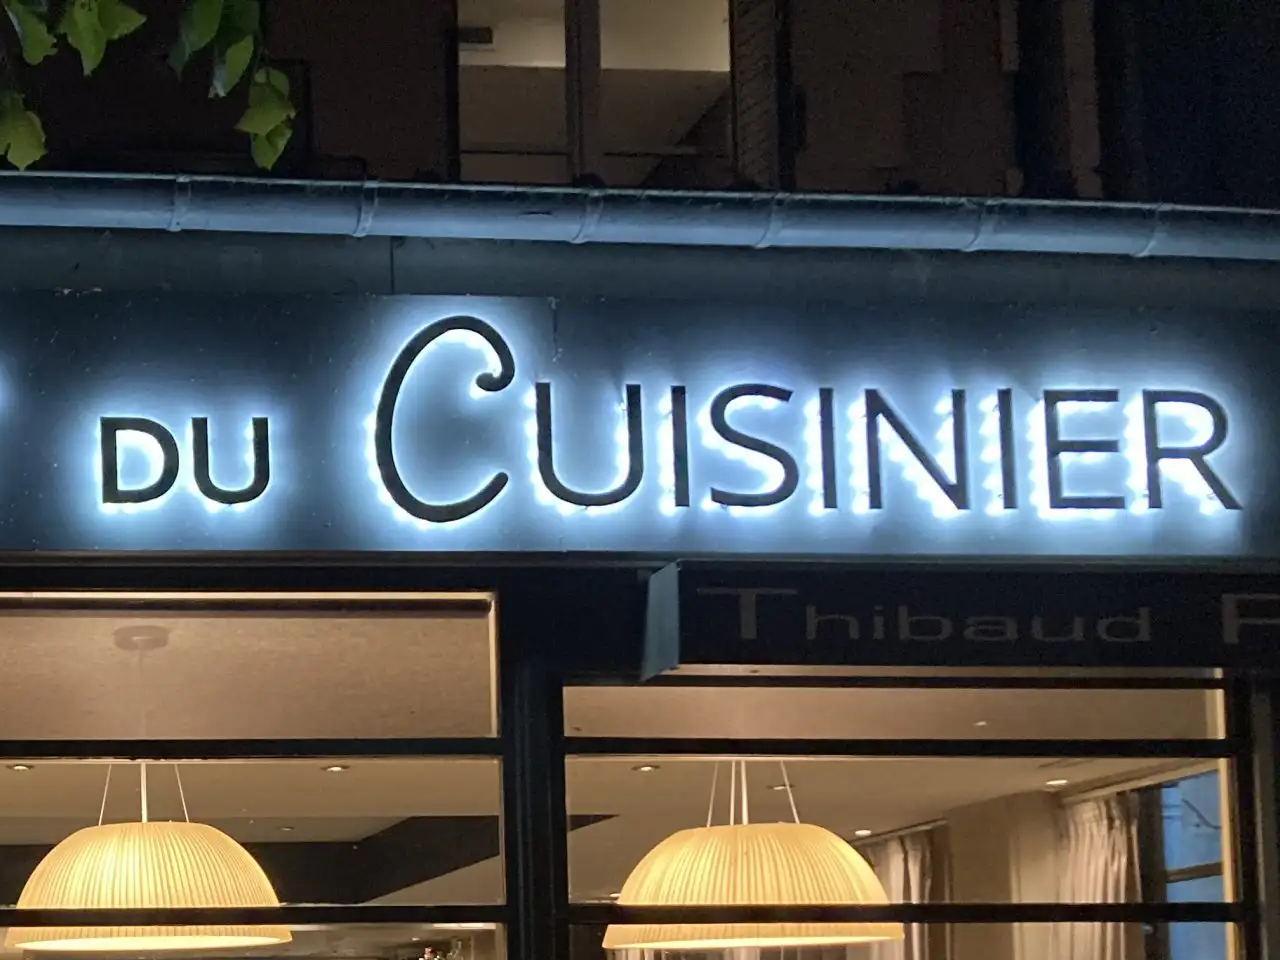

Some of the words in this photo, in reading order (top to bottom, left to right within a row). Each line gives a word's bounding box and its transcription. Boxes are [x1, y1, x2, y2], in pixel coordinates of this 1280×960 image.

[100, 416, 270, 505] DU
[375, 315, 1244, 523] CUISINIER
[696, 587, 1151, 644] Thibaud
